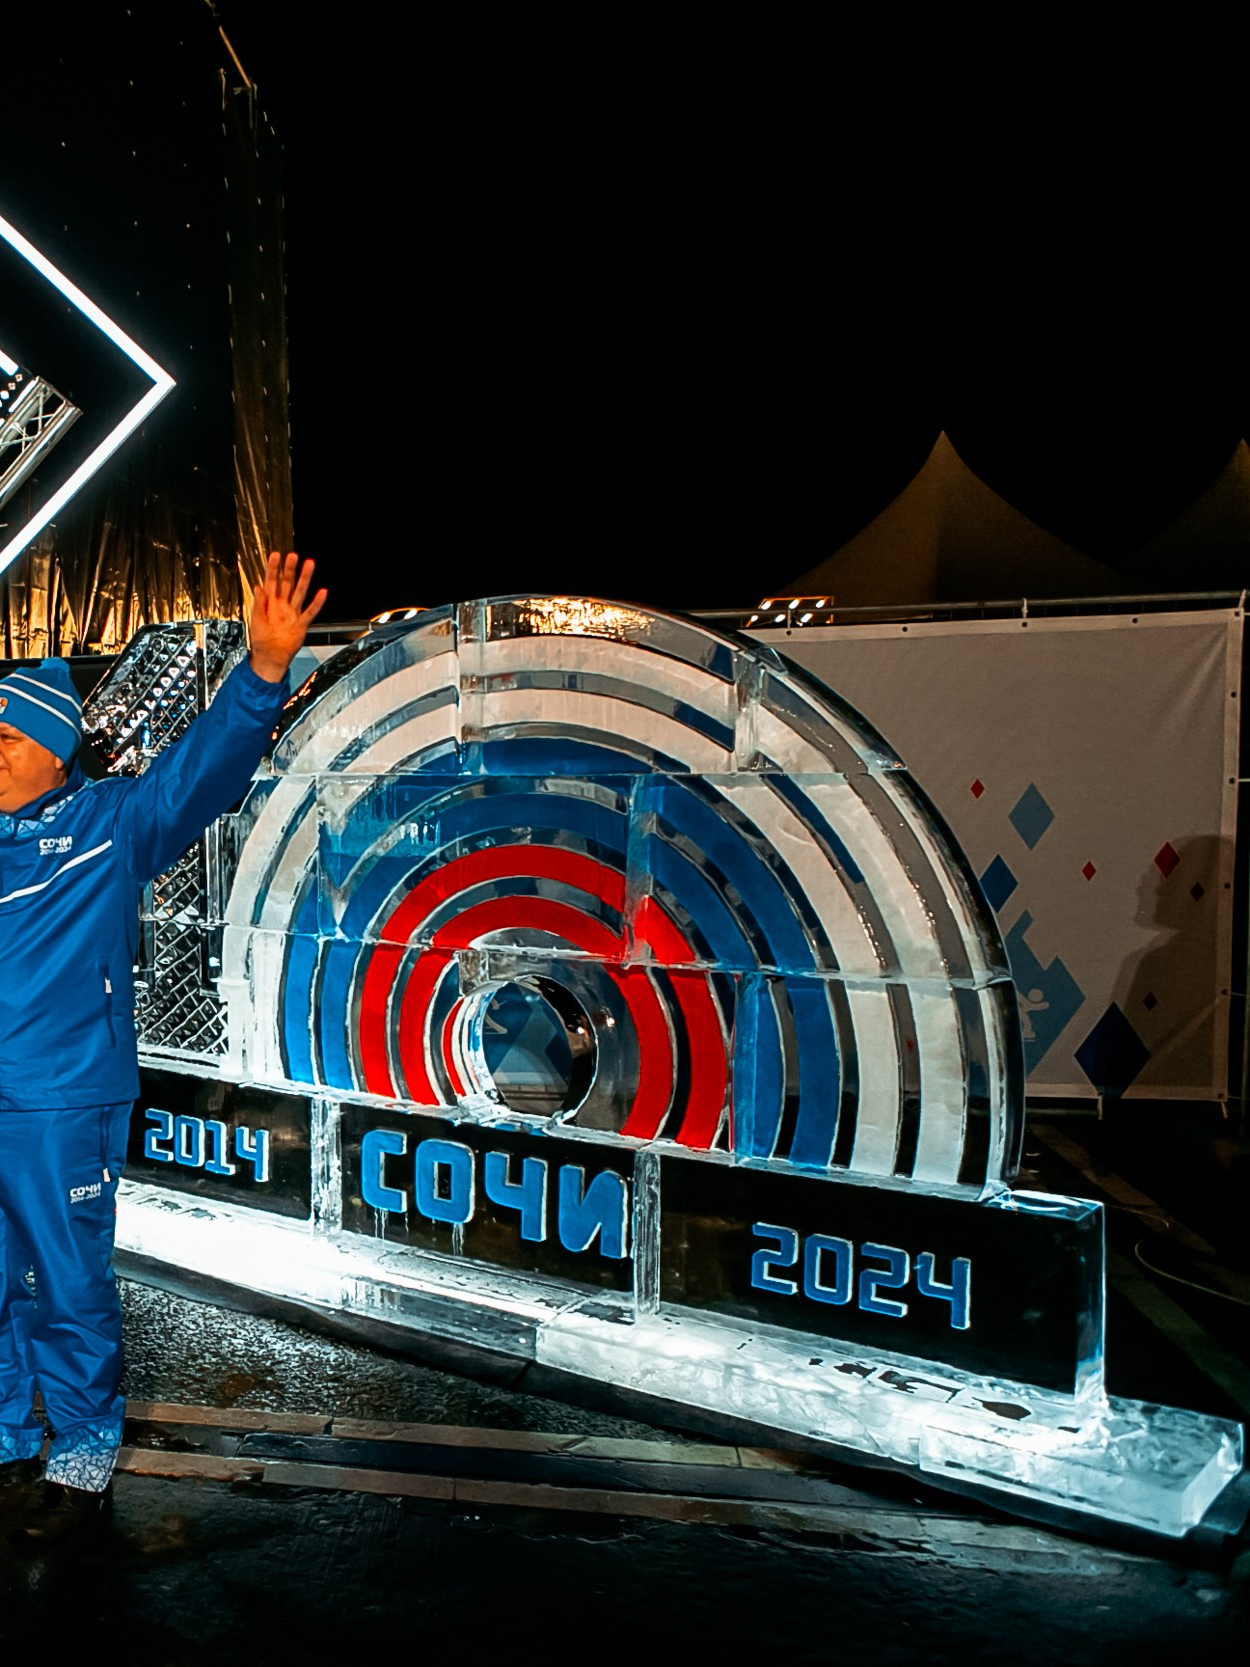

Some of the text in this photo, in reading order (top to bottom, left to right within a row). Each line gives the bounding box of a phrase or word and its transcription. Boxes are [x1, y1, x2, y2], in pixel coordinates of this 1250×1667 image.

[39, 836, 72, 848] СОЧИ
[70, 1182, 101, 1198] СОЧИ
[145, 1108, 972, 1330] 2014 СОЧИ 2024
